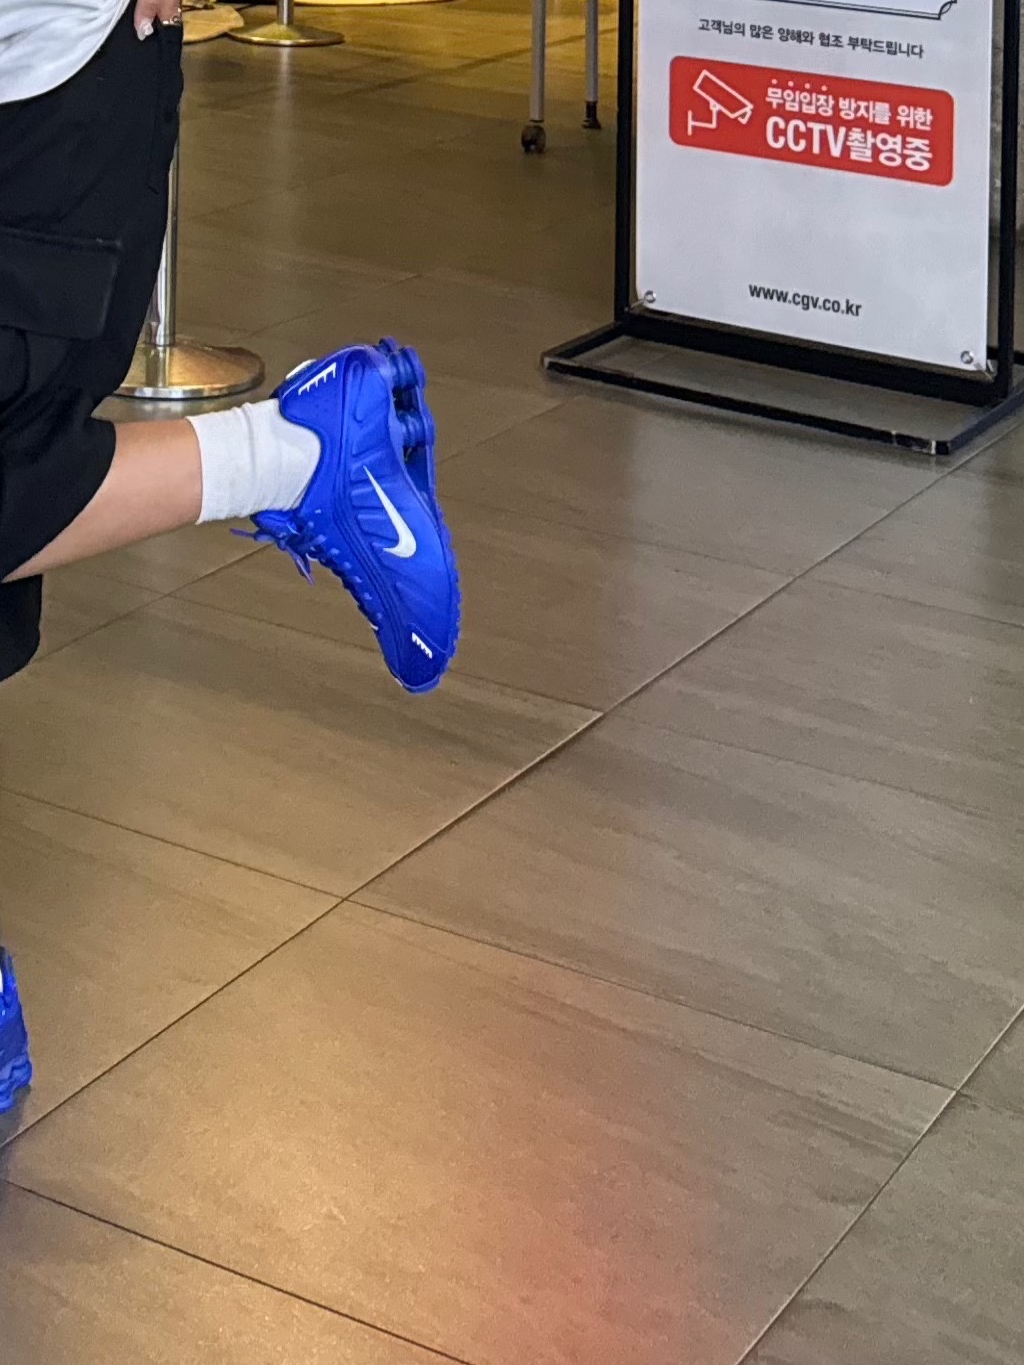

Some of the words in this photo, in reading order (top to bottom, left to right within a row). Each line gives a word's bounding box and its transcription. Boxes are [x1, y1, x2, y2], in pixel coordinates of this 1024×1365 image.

[698, 18, 746, 37] 고객님의
[749, 24, 775, 41] 많은
[777, 27, 815, 46] 양해와
[818, 32, 844, 49] 협조
[847, 35, 924, 59] 부탁드립니다
[765, 87, 834, 117] 무임입장
[838, 96, 892, 125] 방지를
[896, 104, 933, 131] 위한
[765, 115, 933, 172] CCTV촬영중
[748, 283, 863, 317] www.cgv.co.kr
